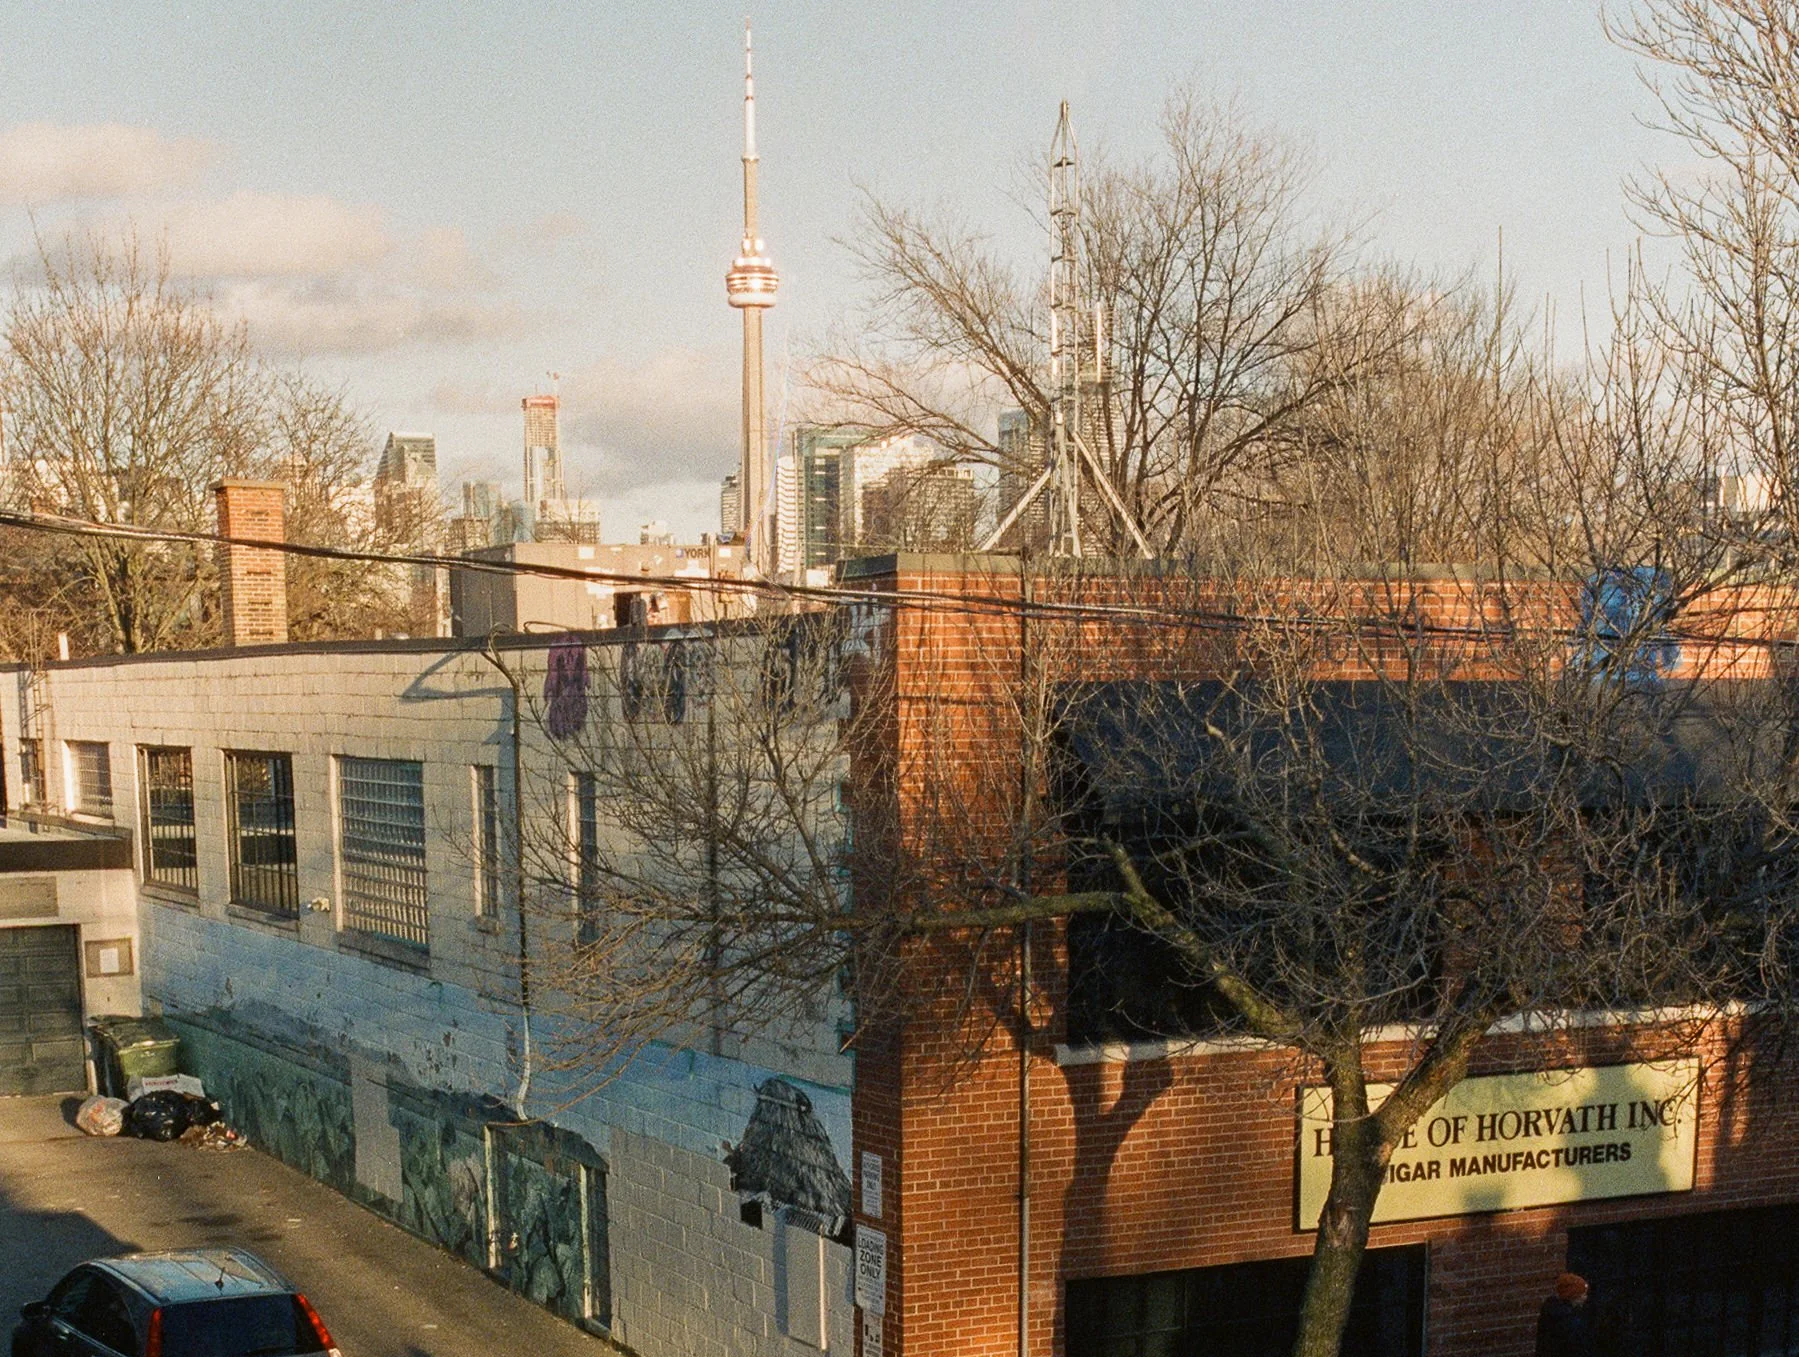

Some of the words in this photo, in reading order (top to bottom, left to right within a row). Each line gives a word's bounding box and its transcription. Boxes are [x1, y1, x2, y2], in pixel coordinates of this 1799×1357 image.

[684, 547, 711, 558] YORK
[1427, 1115, 1468, 1148] OF
[1475, 1102, 1617, 1142] HORVATH
[1628, 1098, 1682, 1128] INC.
[1385, 1160, 1441, 1184] IGAR
[1449, 1142, 1631, 1178] MANUFACTURERS
[858, 1237, 884, 1255] LOADING
[860, 1250, 882, 1268] ZONE
[860, 1264, 881, 1279] ONLY
